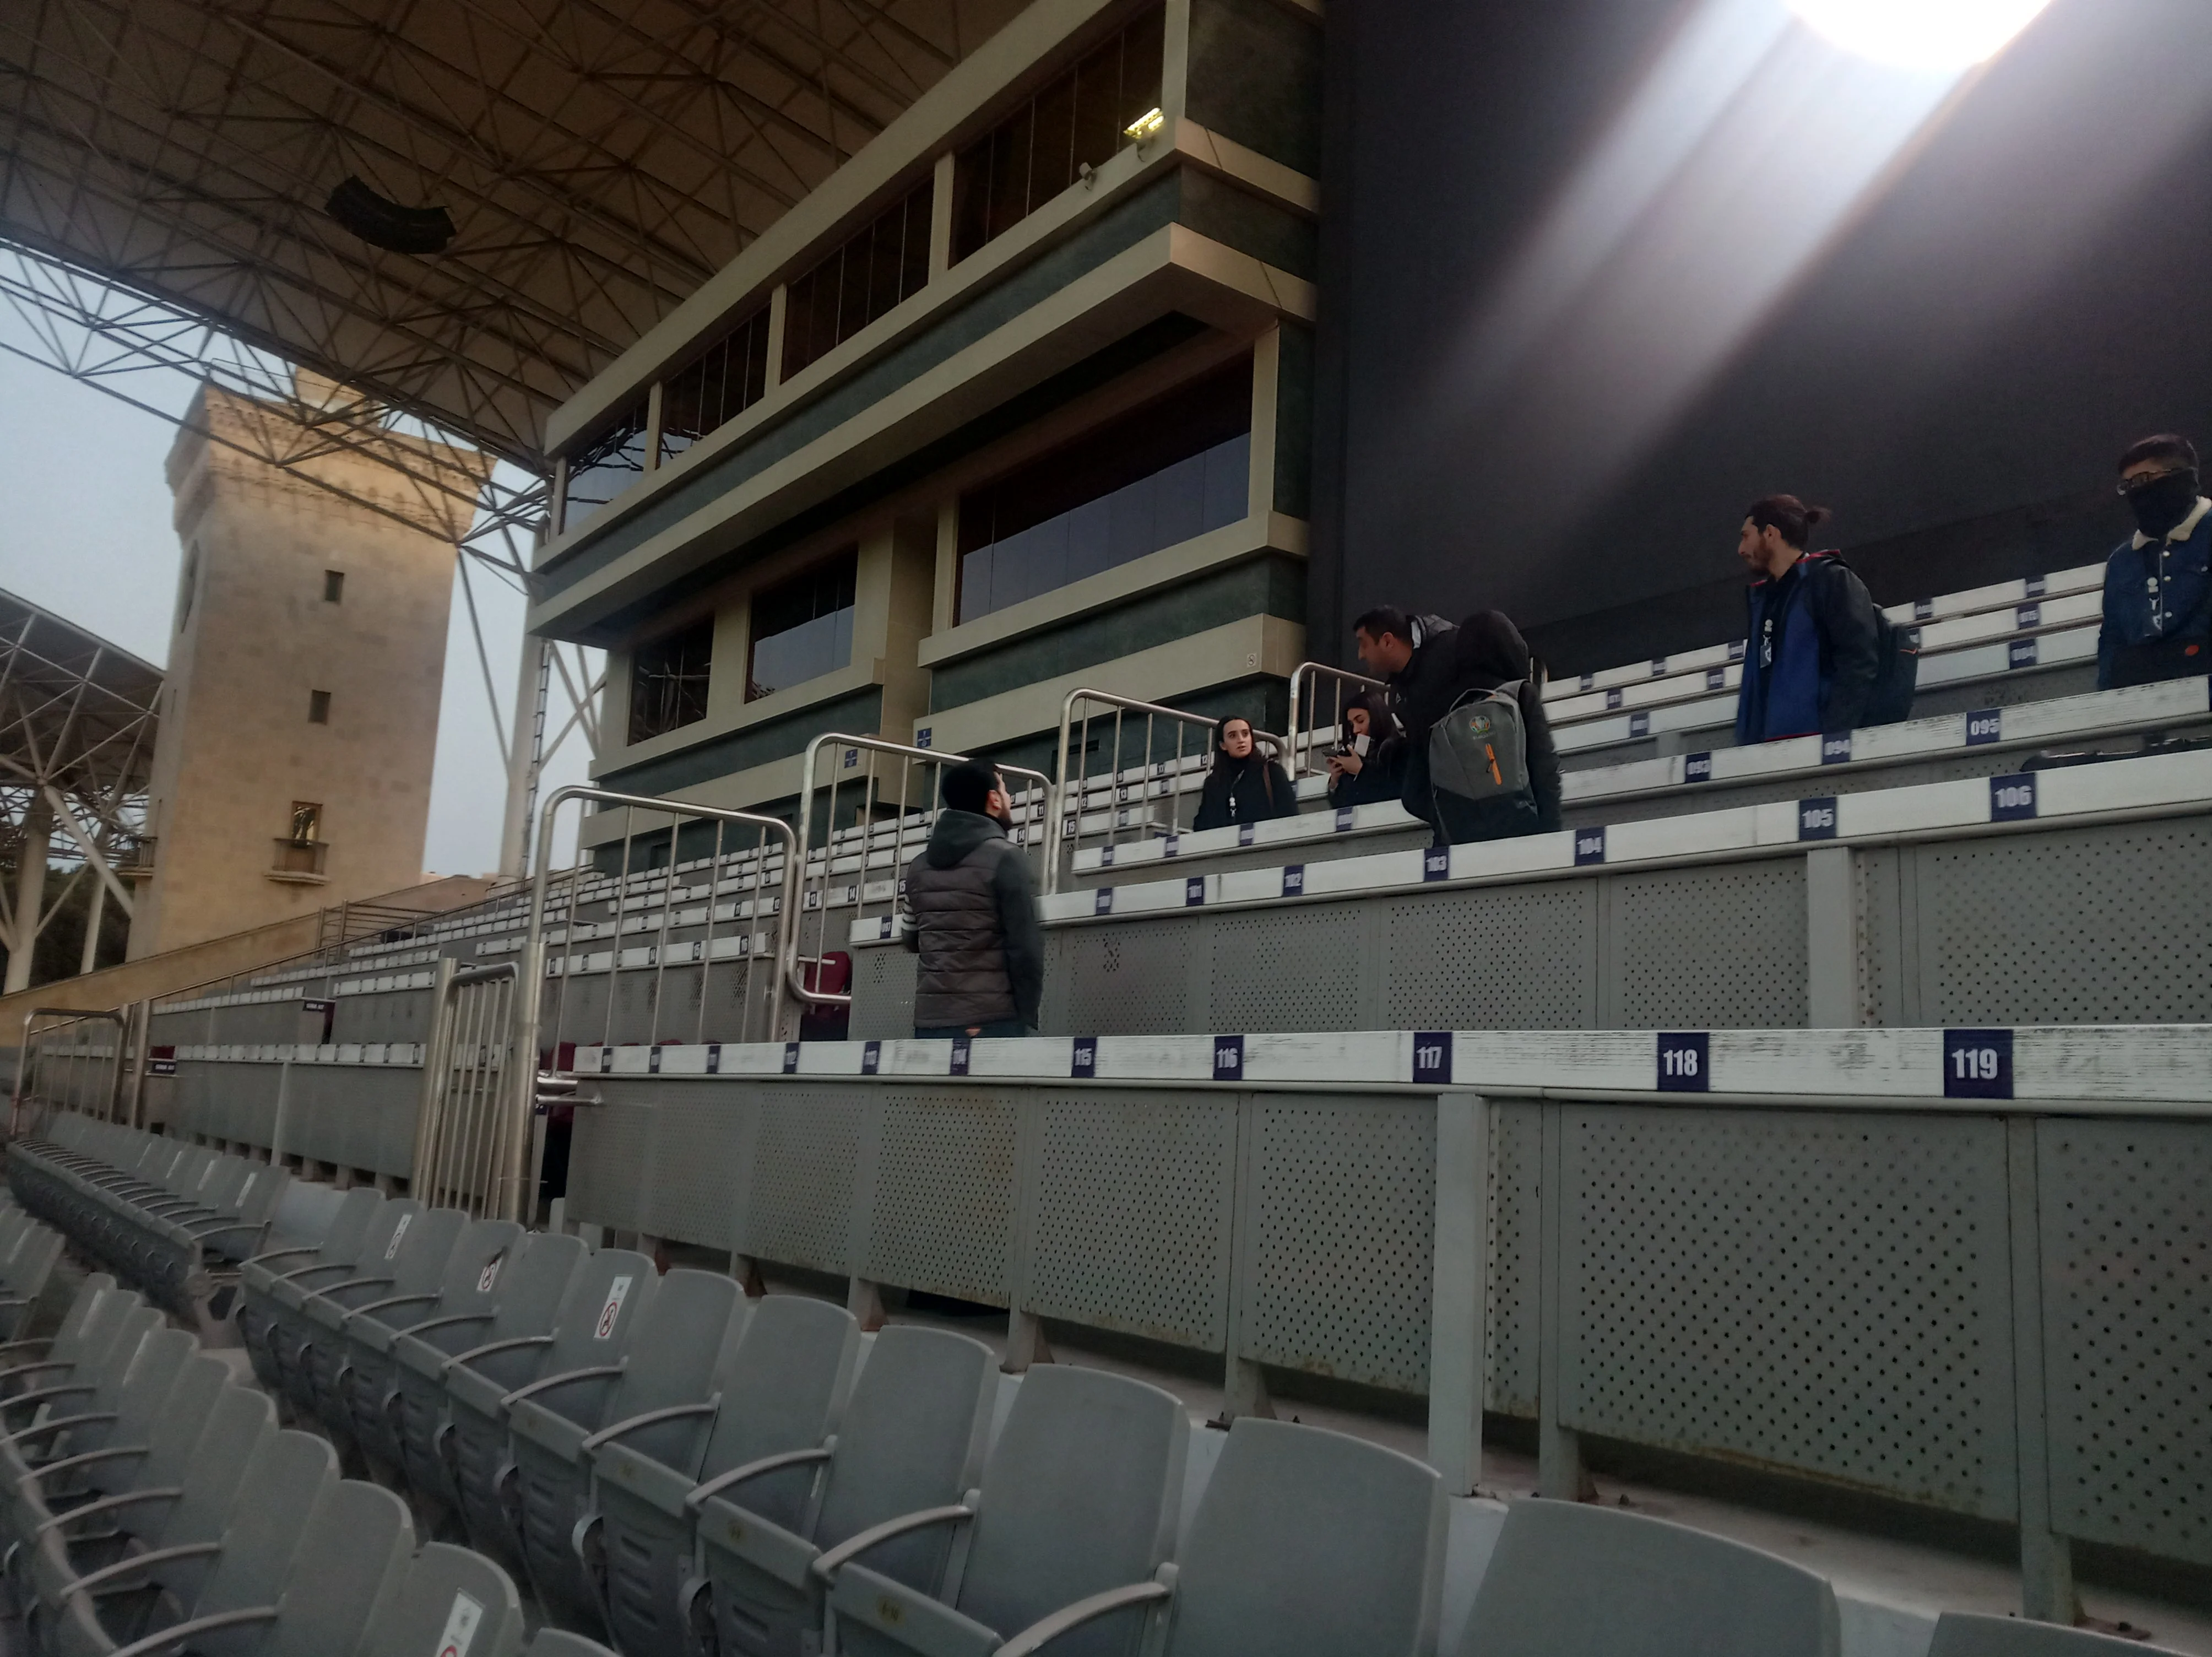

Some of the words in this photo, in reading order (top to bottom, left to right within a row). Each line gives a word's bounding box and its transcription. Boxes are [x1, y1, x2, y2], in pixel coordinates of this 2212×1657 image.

[1971, 718, 1999, 736] 095
[1995, 786, 2031, 808] 106
[1802, 808, 1833, 829] 105
[1577, 837, 1602, 854] 104
[898, 880, 906, 892] 15
[1075, 1048, 1092, 1066] 115
[1216, 1048, 1237, 1069] 116
[1417, 1046, 1442, 1069] 117
[1663, 1049, 1698, 1076] 118
[1951, 1048, 1998, 1080] 119
